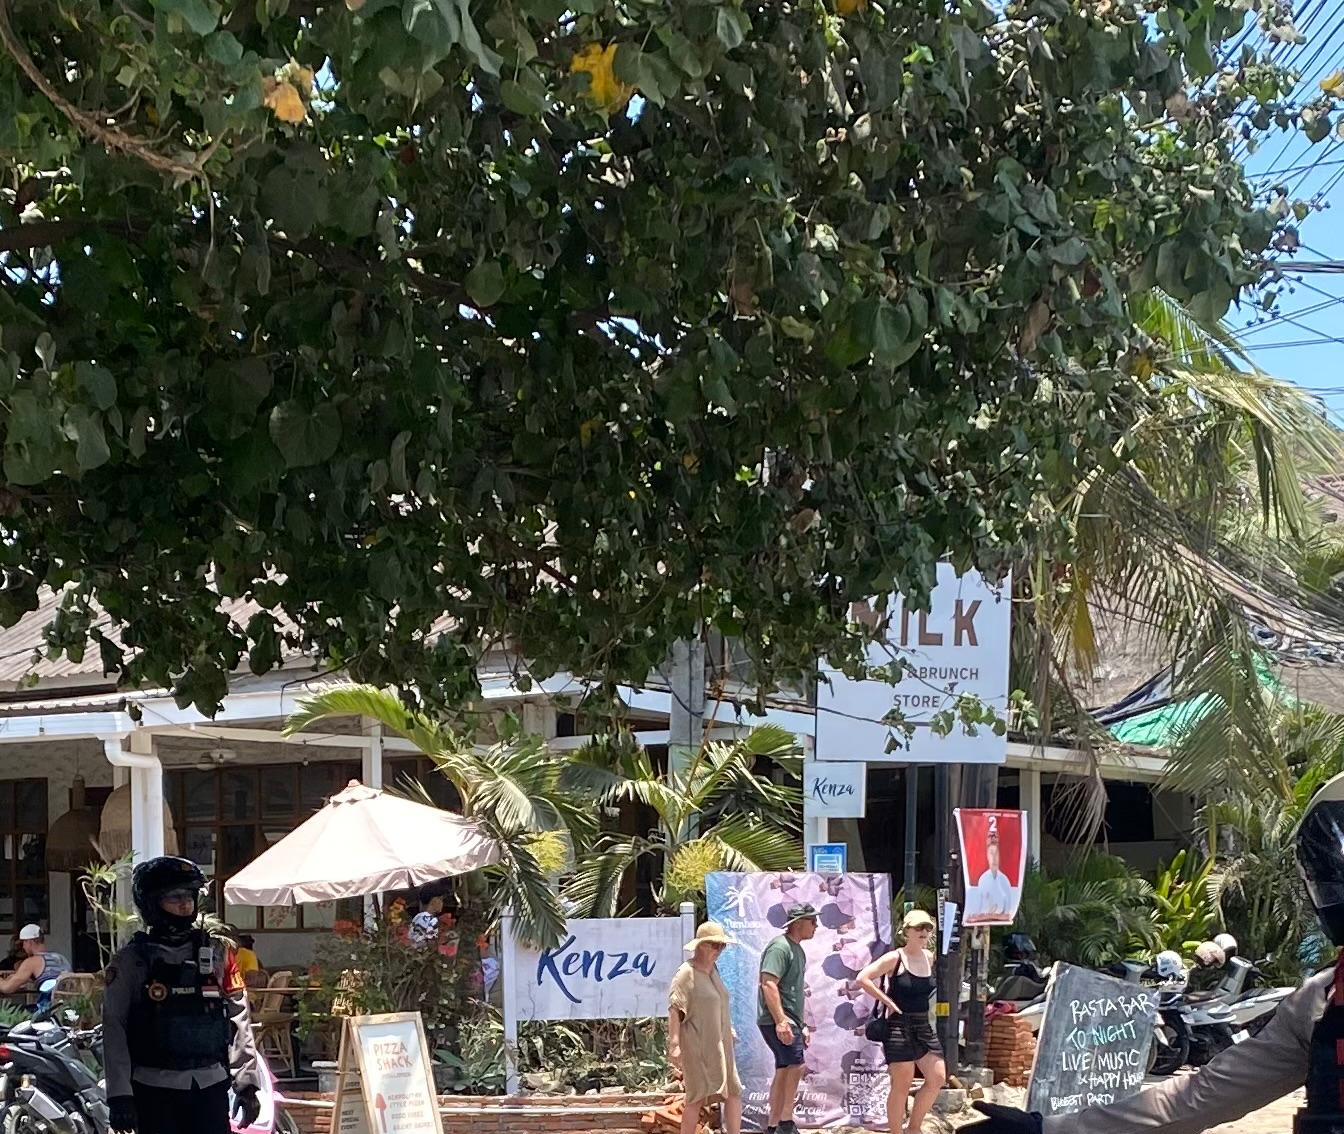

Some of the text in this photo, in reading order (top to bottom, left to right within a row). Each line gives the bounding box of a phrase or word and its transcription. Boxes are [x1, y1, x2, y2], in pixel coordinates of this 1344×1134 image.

[893, 695, 940, 708] STORE
[812, 777, 855, 805] Kenza
[988, 816, 997, 831] 2
[537, 935, 656, 1003] Kenza
[1070, 993, 1155, 1024] RASTA BAR
[1090, 1020, 1137, 1046] NIGHT
[373, 1042, 408, 1056] PIZZA
[377, 1055, 414, 1071] SHACK
[1062, 1049, 1141, 1071] LIVE MUSIC
[1088, 1070, 1122, 1090] HAPPY
[1087, 1093, 1115, 1106] PARTY
